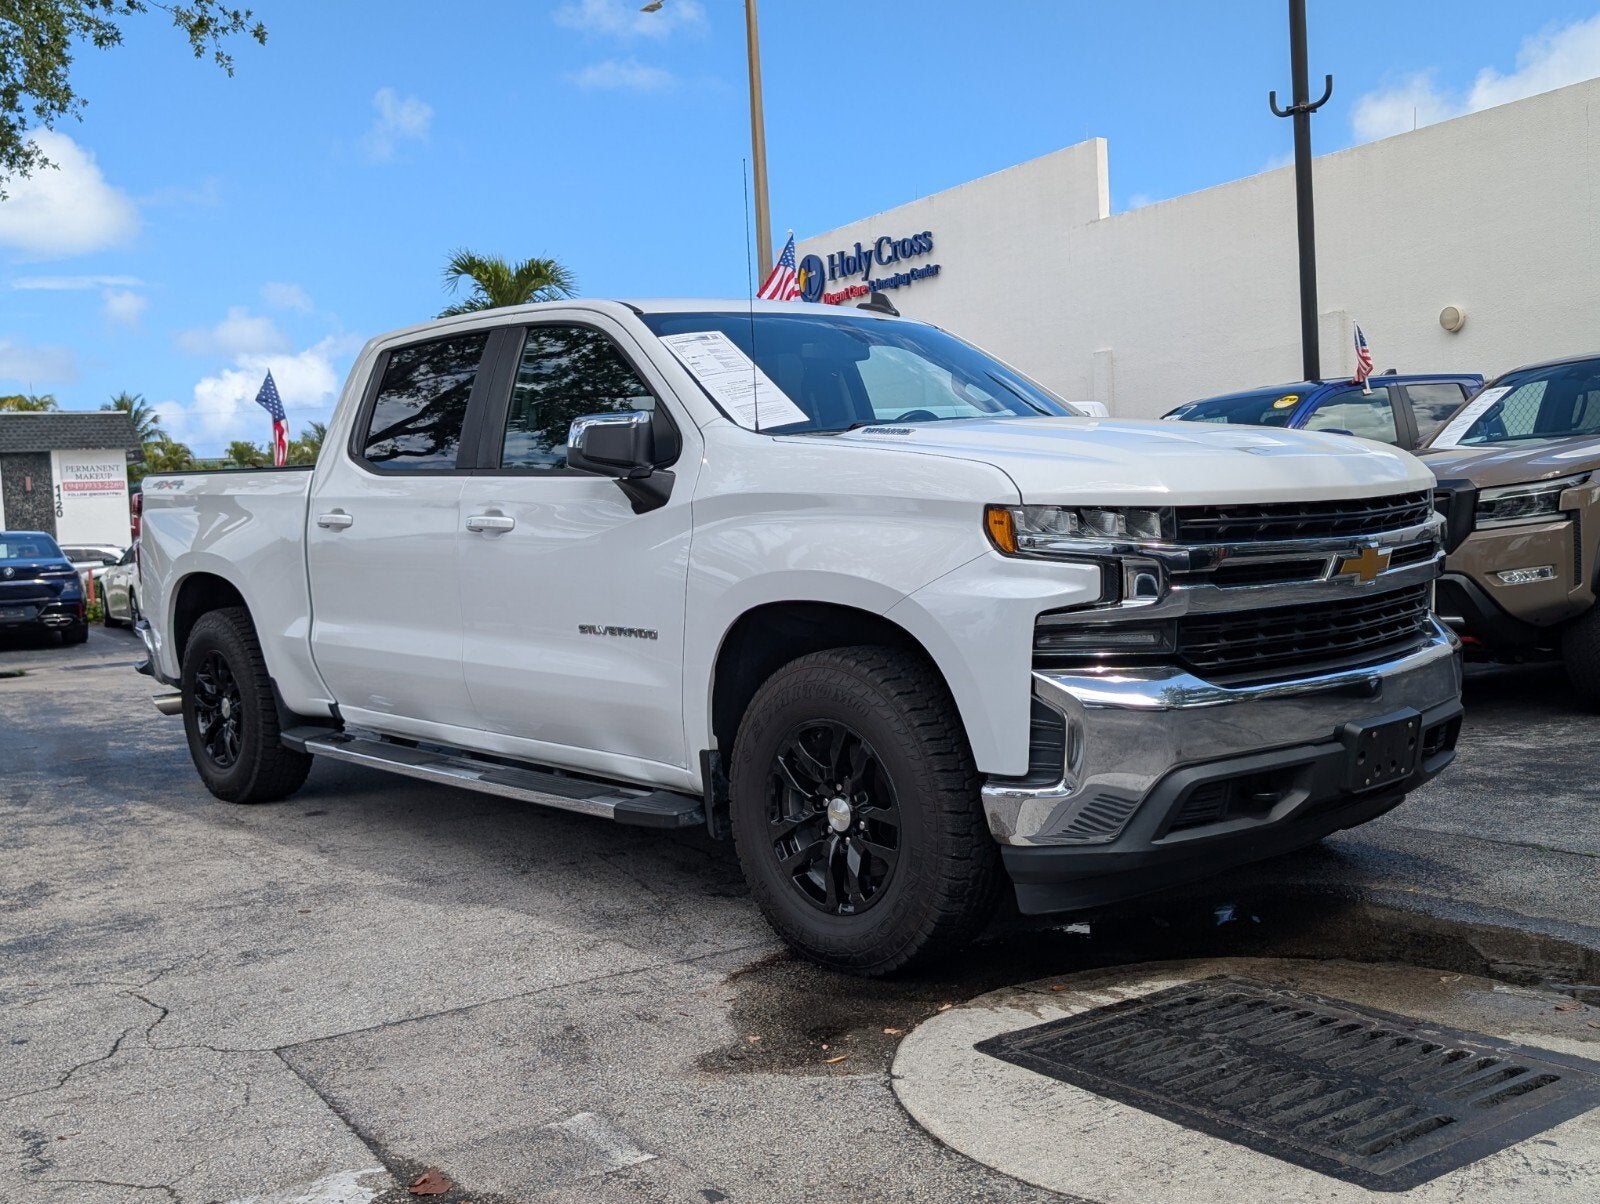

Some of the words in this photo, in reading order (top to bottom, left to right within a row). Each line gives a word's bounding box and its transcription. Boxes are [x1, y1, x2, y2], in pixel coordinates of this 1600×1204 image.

[827, 242, 873, 281] Holy
[874, 230, 932, 265] Cross
[823, 287, 849, 305] Urgent
[849, 285, 869, 299] Care
[876, 273, 911, 290] Imaging
[910, 264, 941, 280] Center
[65, 464, 120, 473] PERMANENT
[55, 484, 63, 518] 1120
[578, 624, 658, 640] SILVERADO
